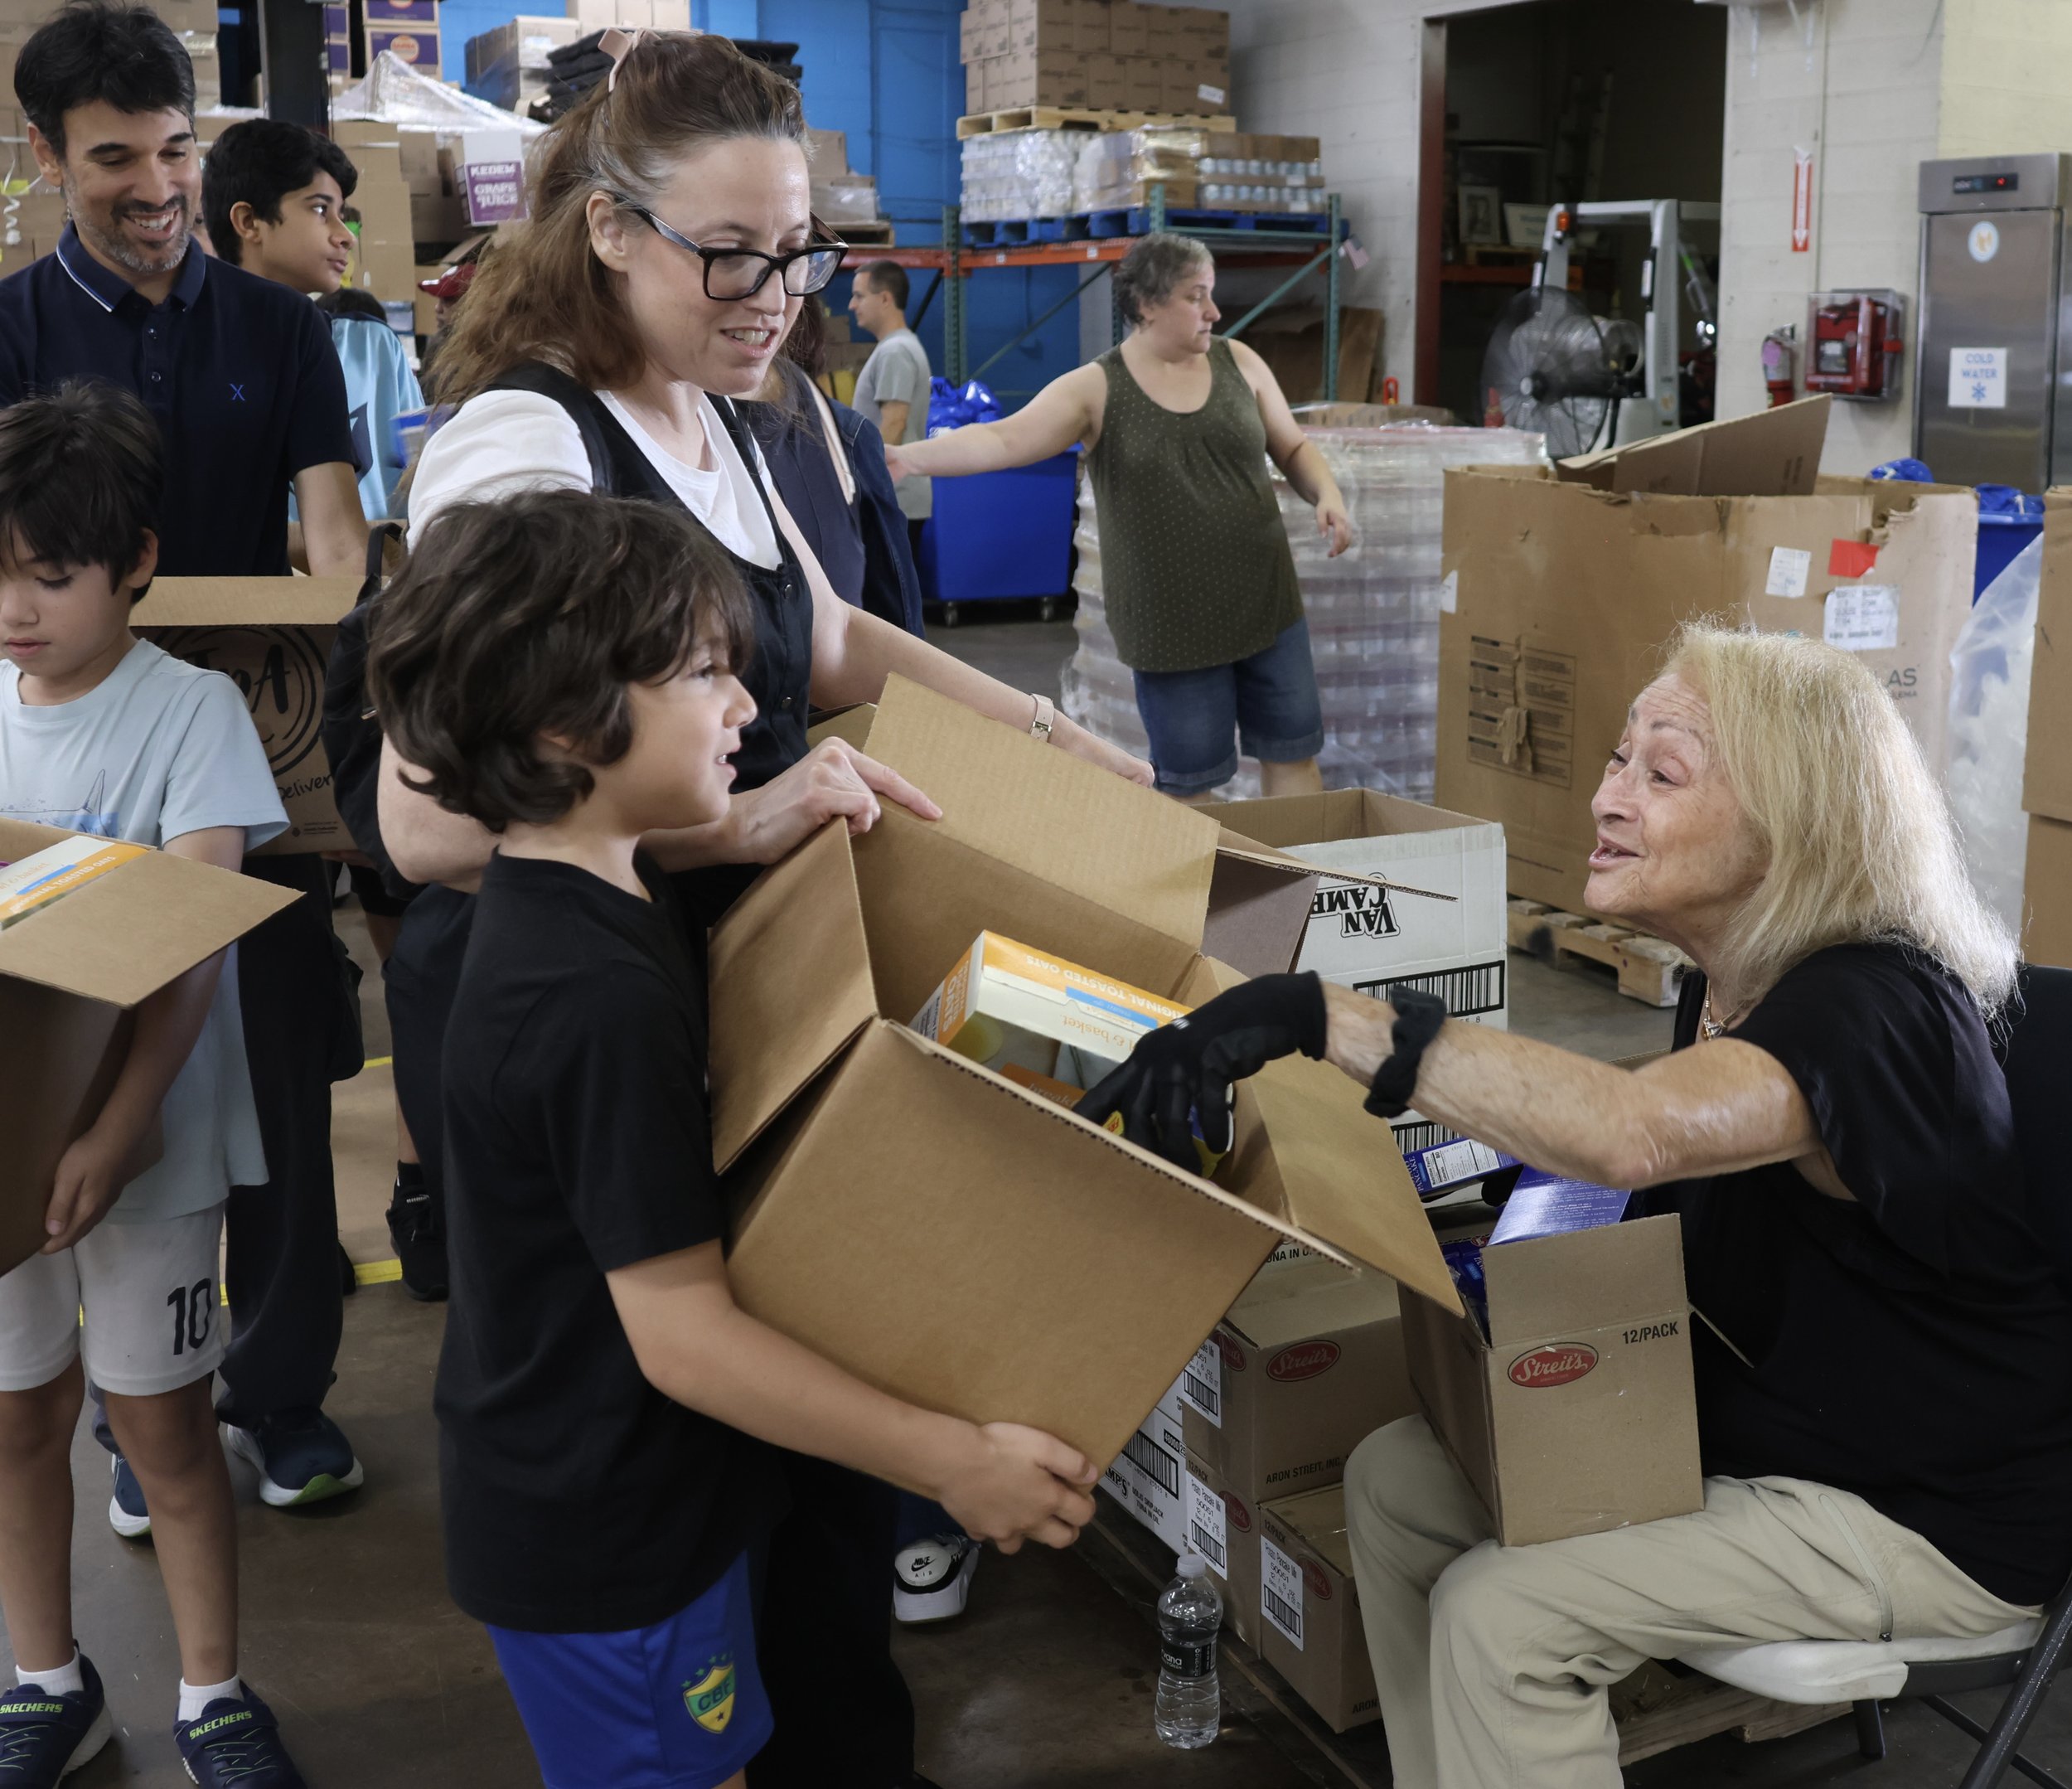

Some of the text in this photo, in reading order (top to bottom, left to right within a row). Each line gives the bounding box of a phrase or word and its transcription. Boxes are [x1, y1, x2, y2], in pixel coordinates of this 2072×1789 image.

[471, 164, 516, 177] KEDEM
[474, 182, 517, 195] GRAPE
[477, 193, 518, 208] JUICE
[1965, 353, 1994, 363] COLD
[1962, 369, 1997, 378] WATER
[57, 865, 94, 887] TOASTED
[93, 856, 117, 869] OATS
[1344, 903, 1397, 935] VAN
[1025, 954, 1061, 972] OATS
[1063, 968, 1125, 999] TOASTED
[1290, 1248, 1300, 1258] IN
[167, 1278, 211, 1355] 10
[1622, 1321, 1679, 1345] 12/PACK
[1273, 1348, 1333, 1375] Streit's
[1516, 1353, 1589, 1383] Streit's
[1188, 1459, 1208, 1484] 12/PACK
[1266, 1468, 1291, 1485] ARON
[1292, 1459, 1324, 1478] STREIT,
[913, 1555, 930, 1566] NIKE
[914, 1570, 932, 1578] AIR
[0, 1702, 63, 1714] SKECHERS
[1352, 1699, 1378, 1714] ARON
[189, 1710, 253, 1740] SKECHERS
